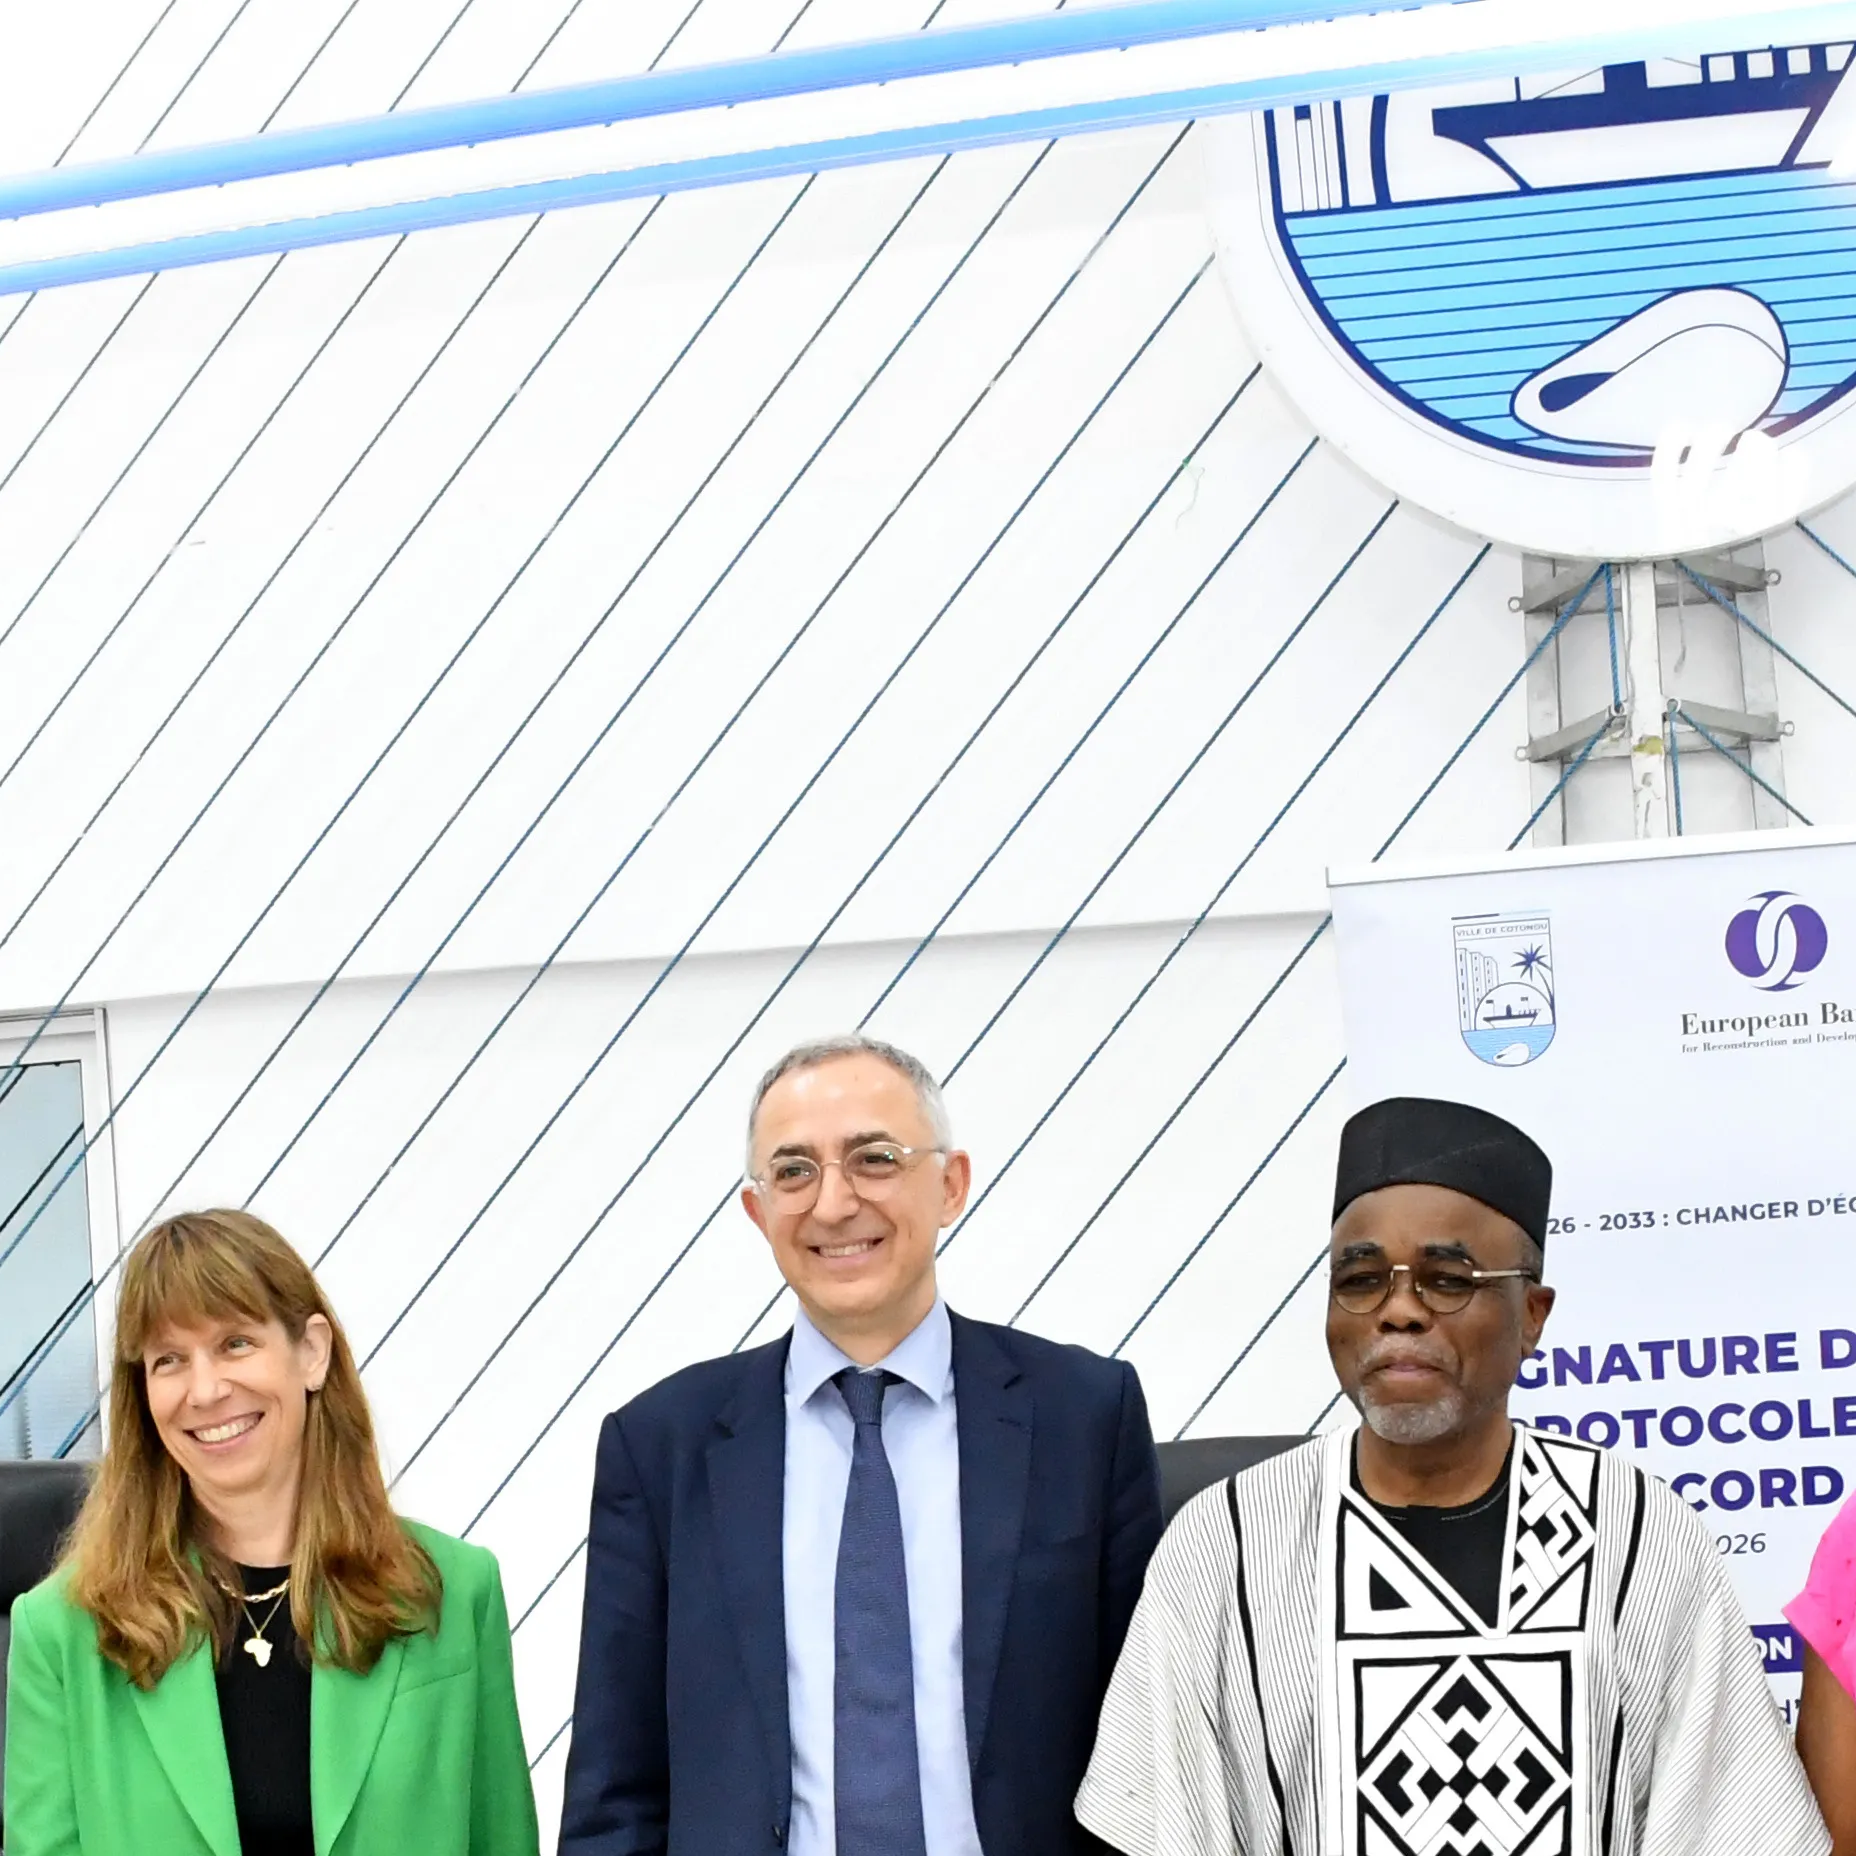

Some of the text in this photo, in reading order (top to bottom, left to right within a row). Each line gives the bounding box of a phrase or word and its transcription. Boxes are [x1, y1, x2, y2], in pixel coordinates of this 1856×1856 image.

[1681, 1011, 1808, 1037] European
[1682, 1043, 1698, 1053] for
[1703, 1038, 1787, 1052] Reconstruction
[1793, 1034, 1812, 1045] and
[1548, 1217, 1576, 1235] 26
[1599, 1211, 1655, 1231] 2033
[1676, 1200, 1799, 1226] CHANGER
[1516, 1331, 1799, 1390] GNATURE
[1655, 1466, 1844, 1512] CORD
[1716, 1533, 1766, 1555] 026
